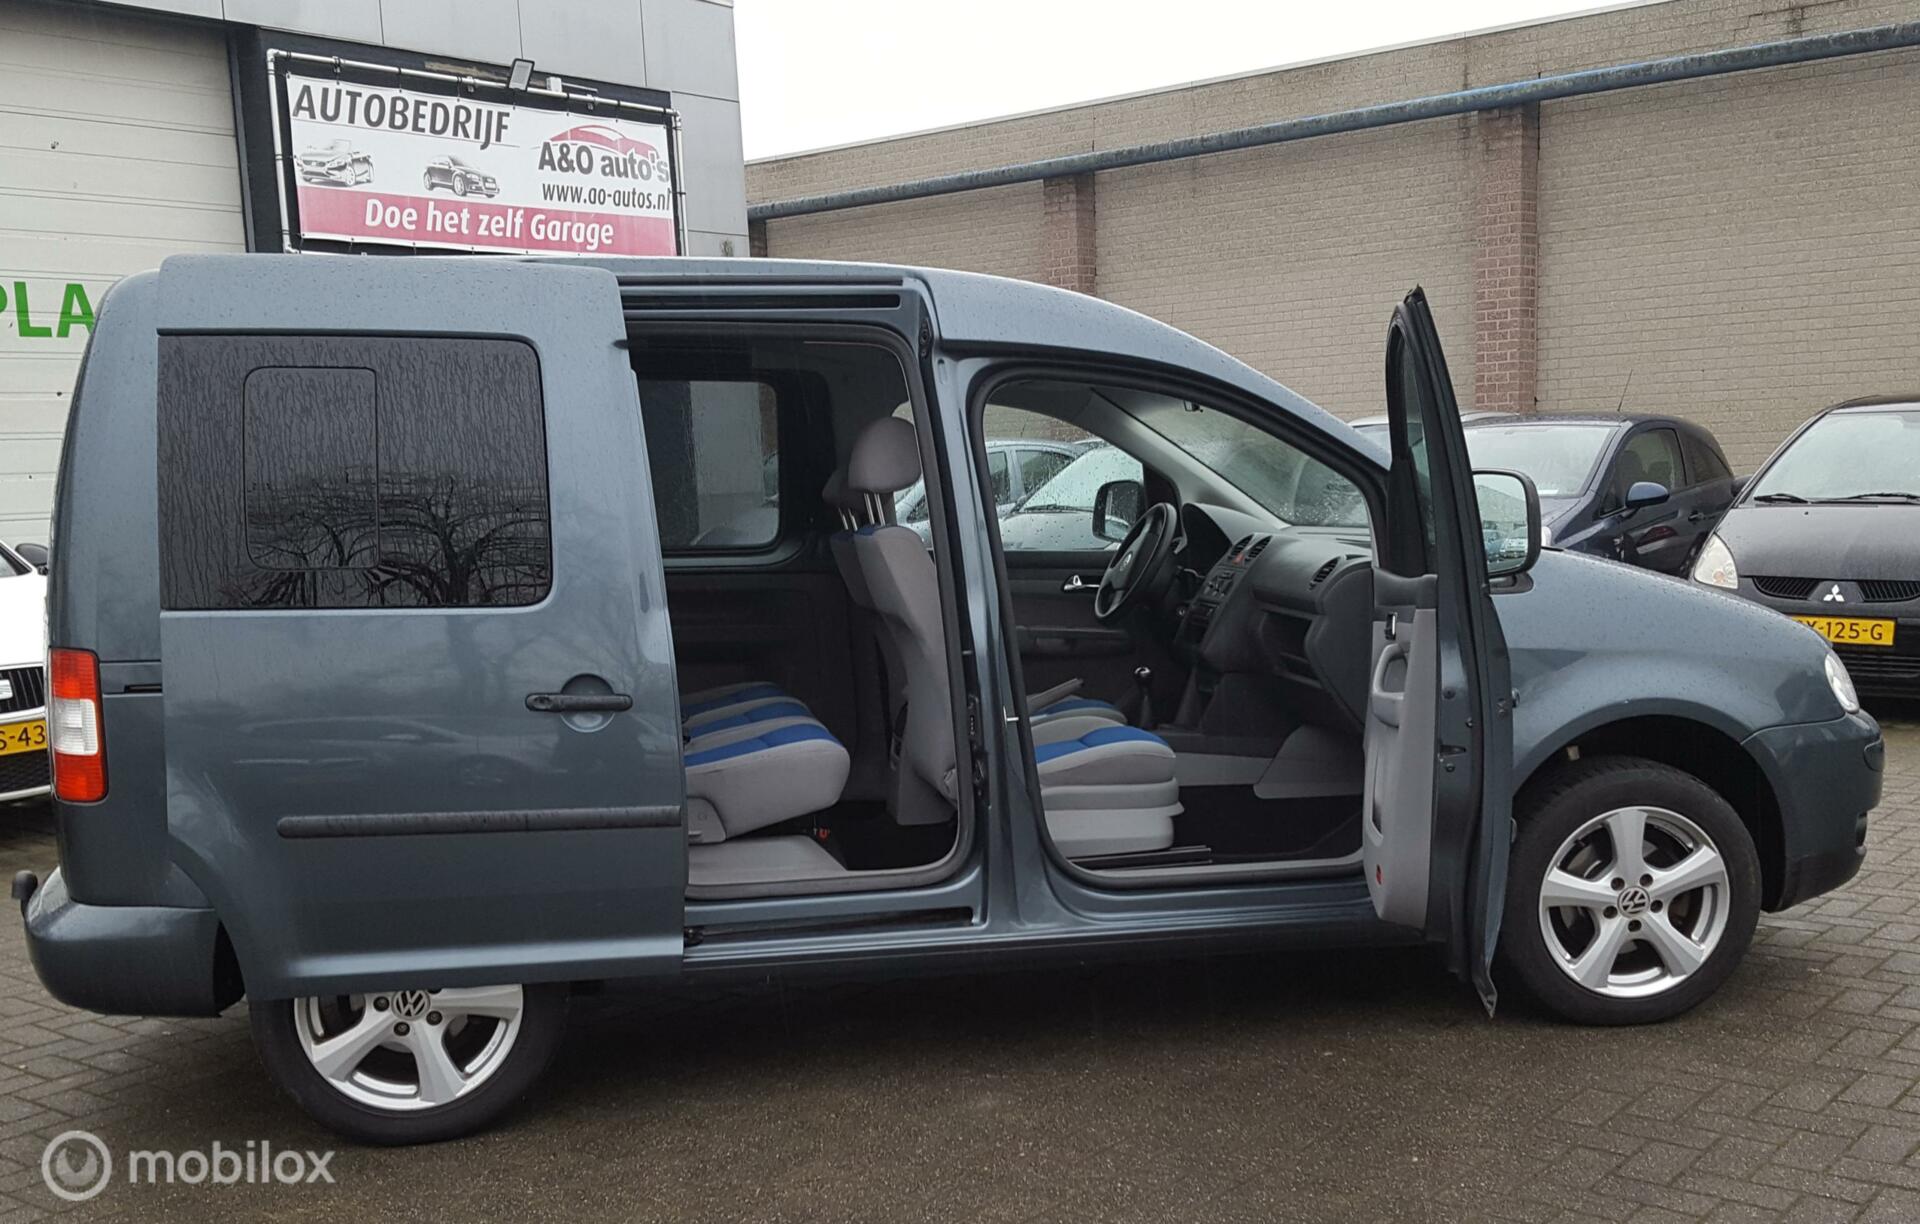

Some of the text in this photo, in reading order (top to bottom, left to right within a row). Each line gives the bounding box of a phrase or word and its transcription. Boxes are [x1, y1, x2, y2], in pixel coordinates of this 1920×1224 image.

[292, 85, 510, 150] AUTOBEDRIJF
[538, 141, 670, 183] A&O auto's
[542, 183, 672, 211] www.ao-autos.nl
[365, 199, 615, 250] Doe het zelf Garage
[0, 281, 95, 338] LA
